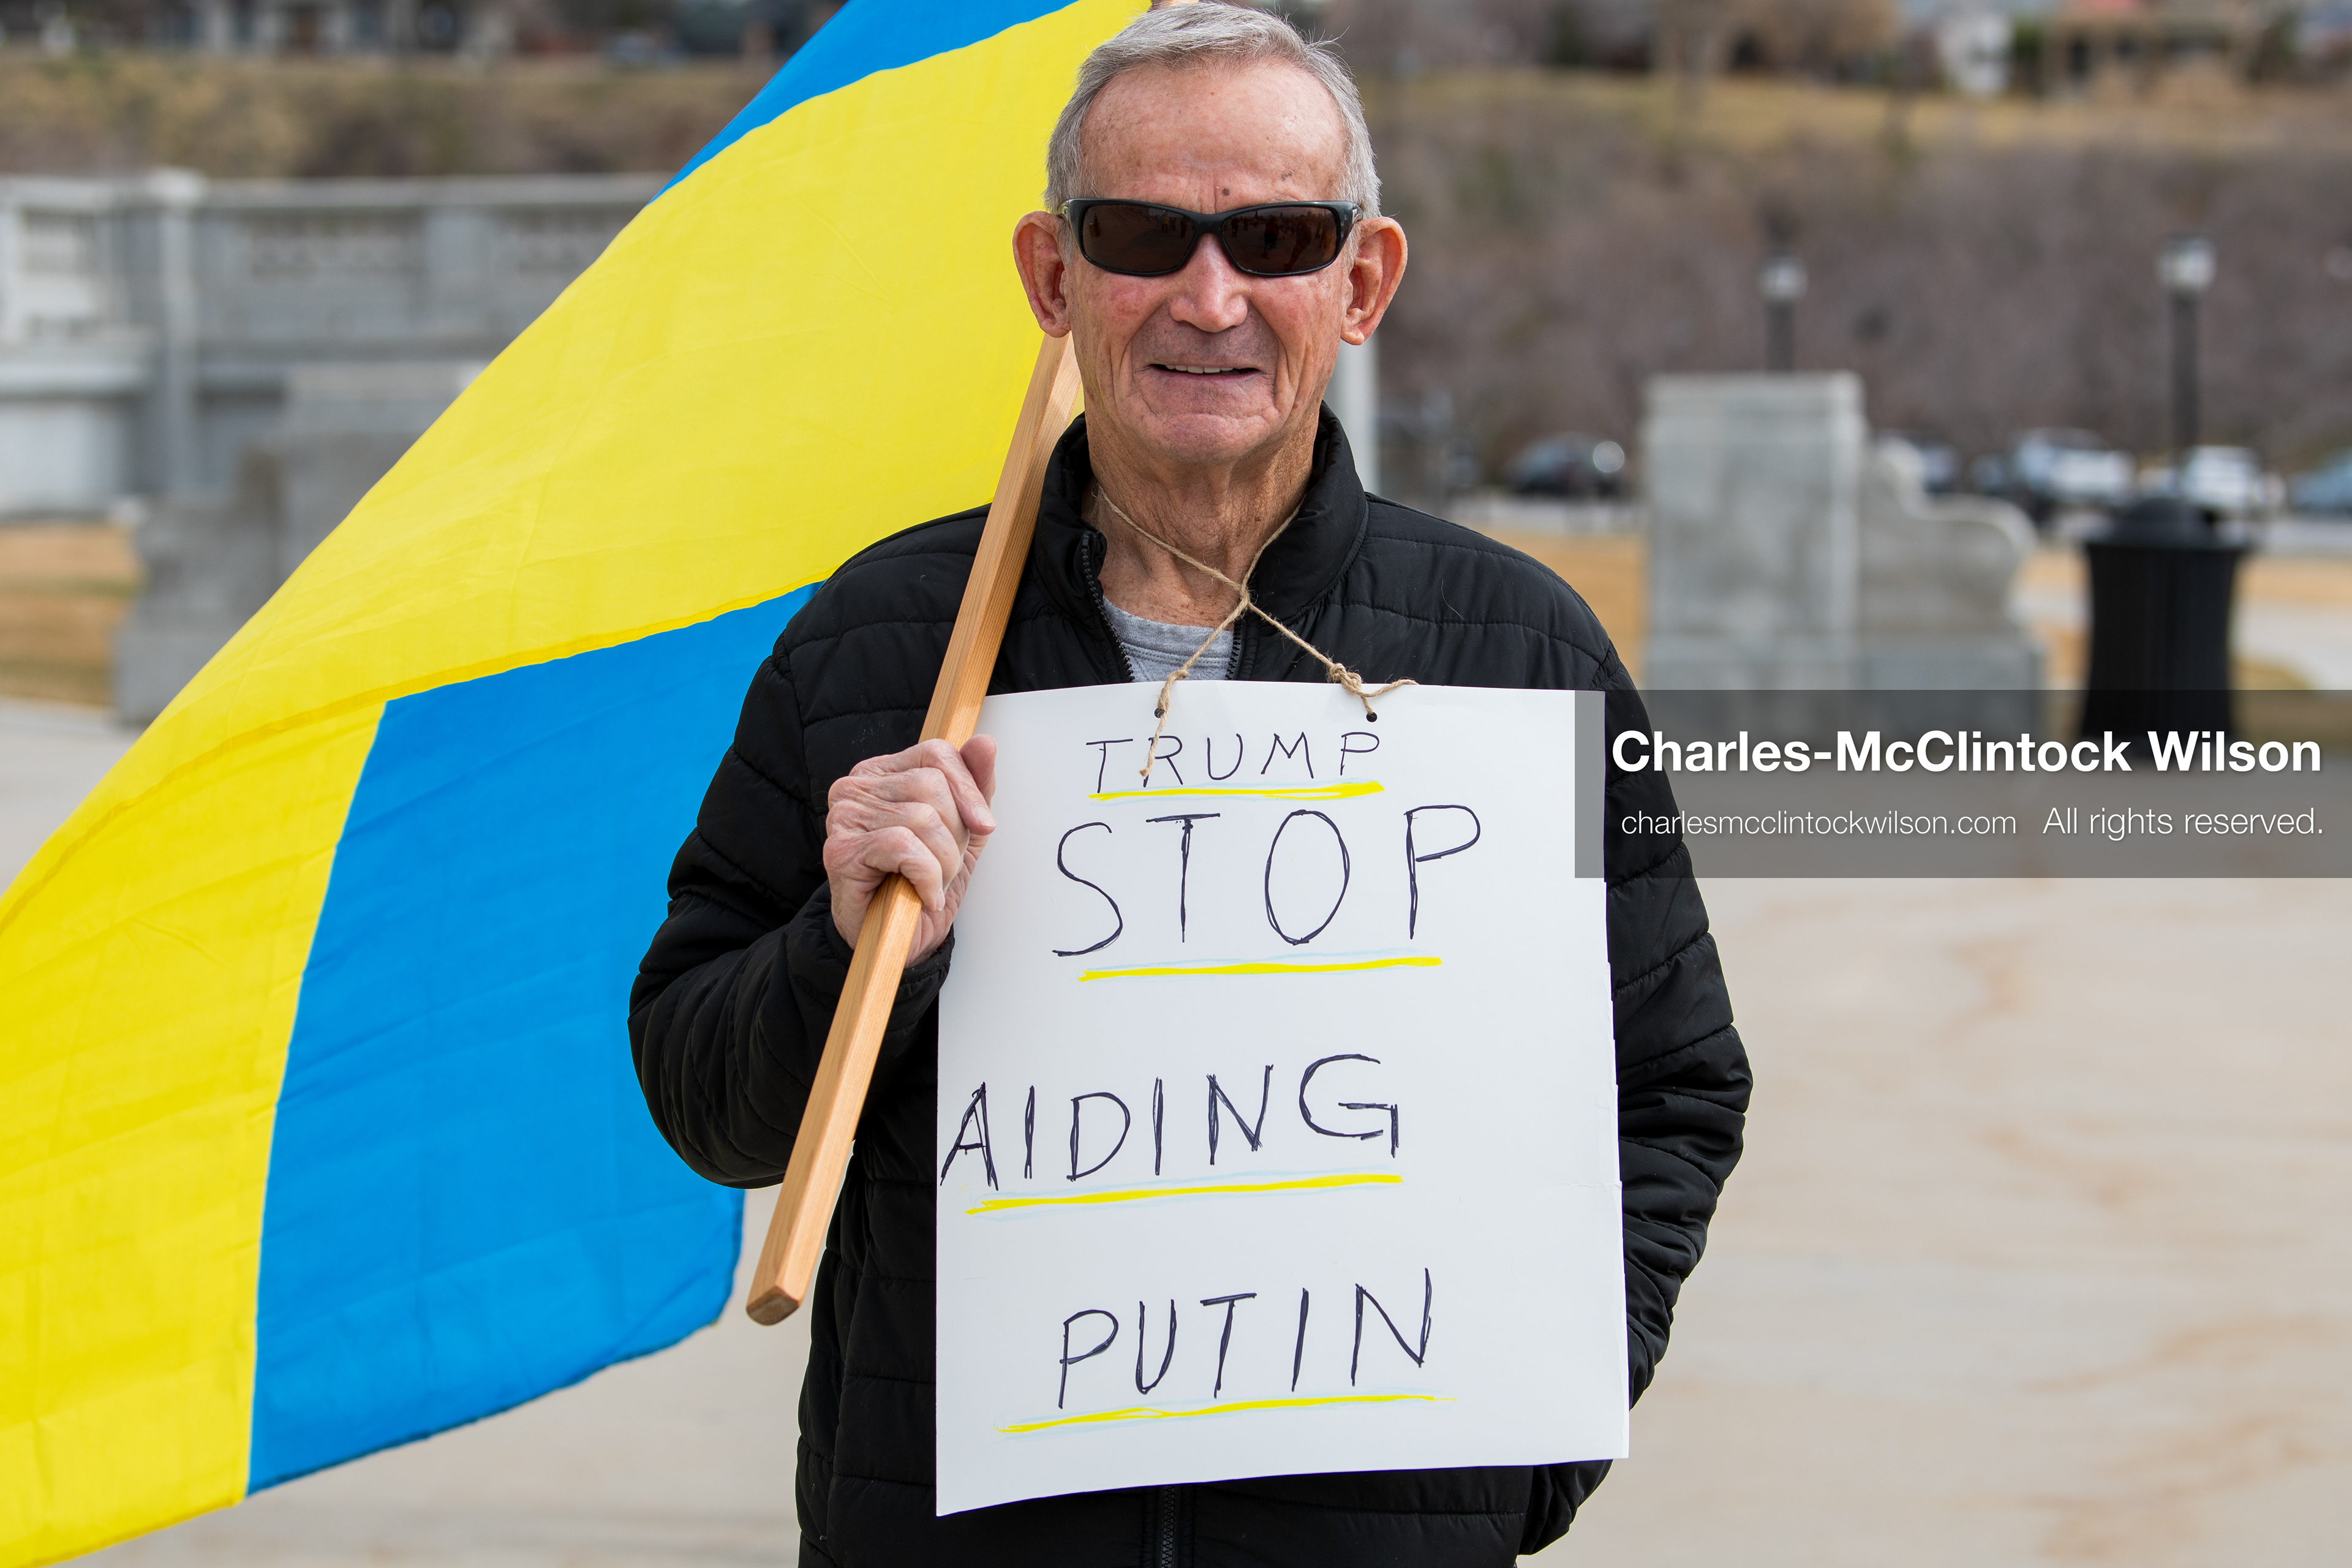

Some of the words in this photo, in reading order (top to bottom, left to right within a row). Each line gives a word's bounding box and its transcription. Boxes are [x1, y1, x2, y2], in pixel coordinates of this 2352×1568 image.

[1085, 731, 1380, 794] TRUMP
[1052, 804, 1482, 957] STOP
[940, 1054, 1400, 1191] AIDING
[1058, 1267, 1433, 1409] PUTIN
